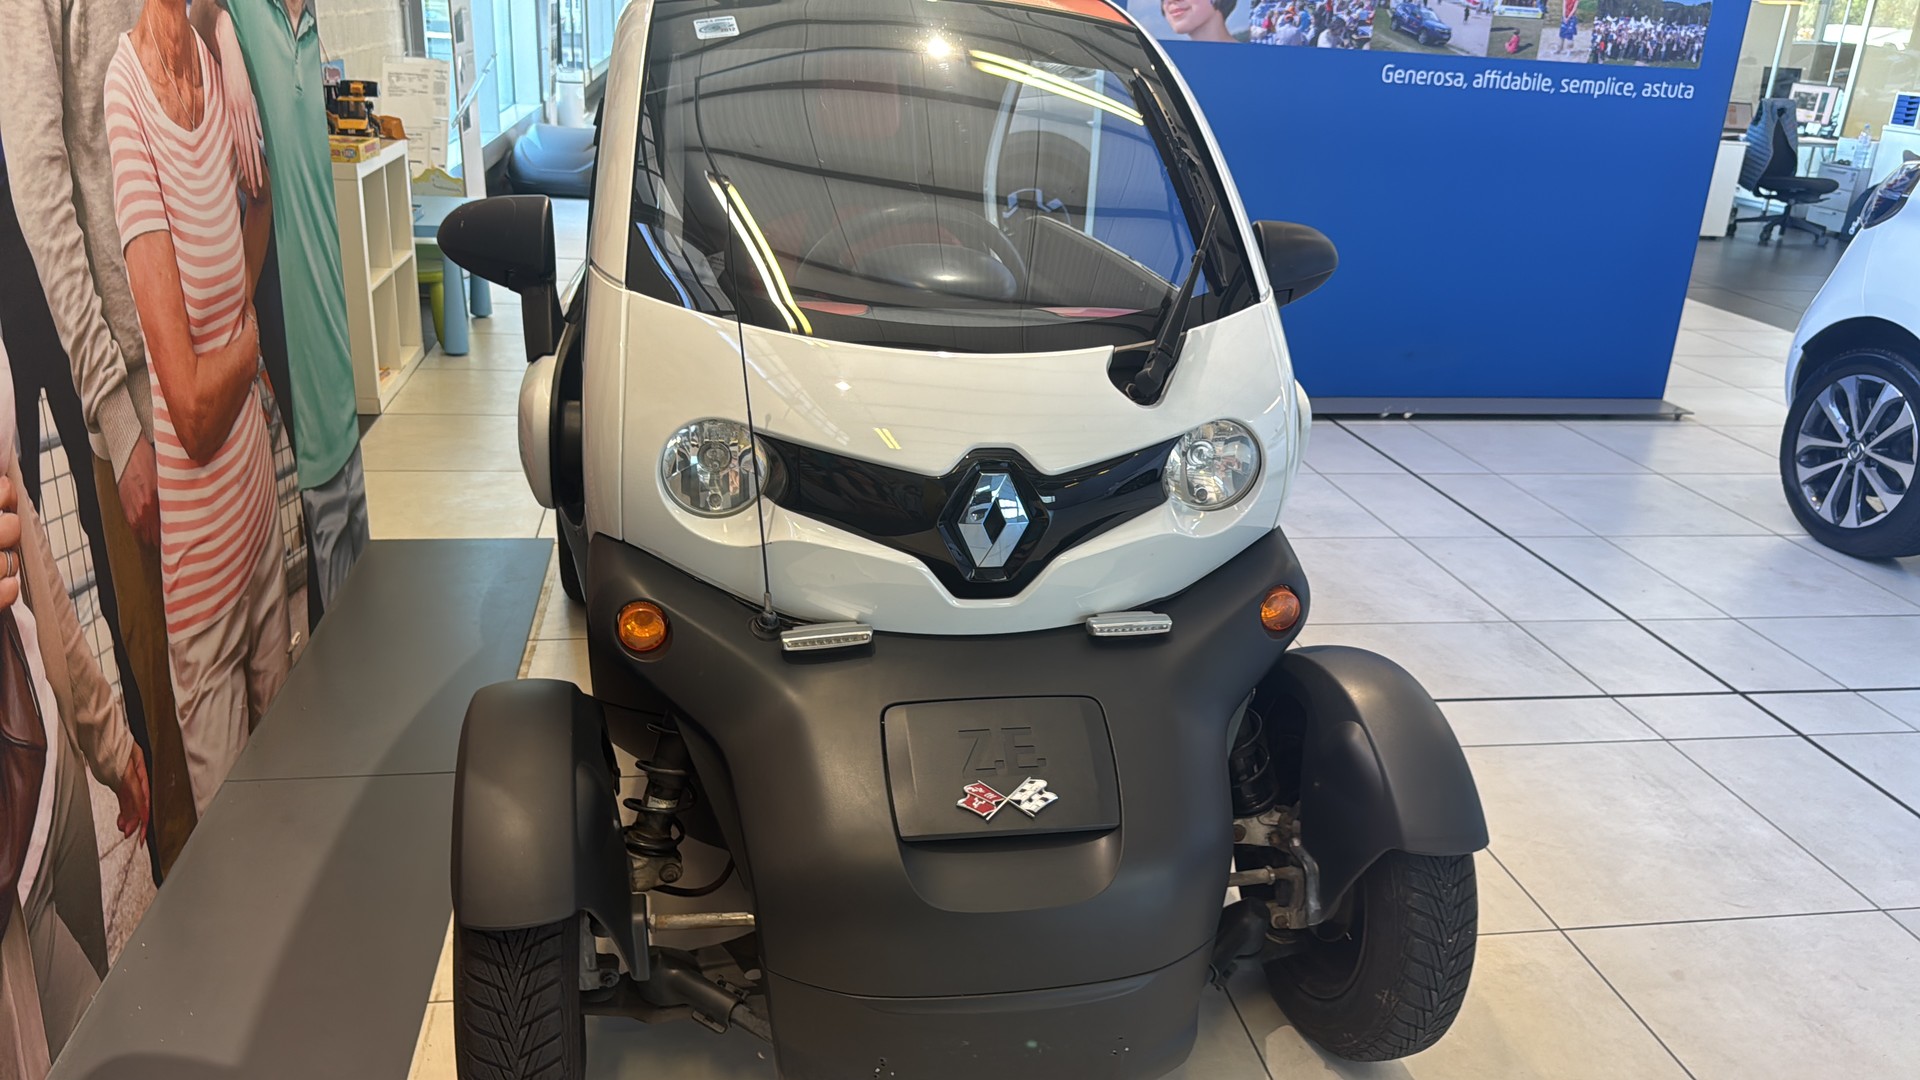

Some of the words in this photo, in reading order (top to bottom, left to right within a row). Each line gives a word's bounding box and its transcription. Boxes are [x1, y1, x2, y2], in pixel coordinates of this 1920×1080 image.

[1381, 63, 1468, 89] Generosa,
[1472, 69, 1555, 94] affidabile,
[1559, 76, 1637, 99] semplice,
[1641, 81, 1695, 99] astuta
